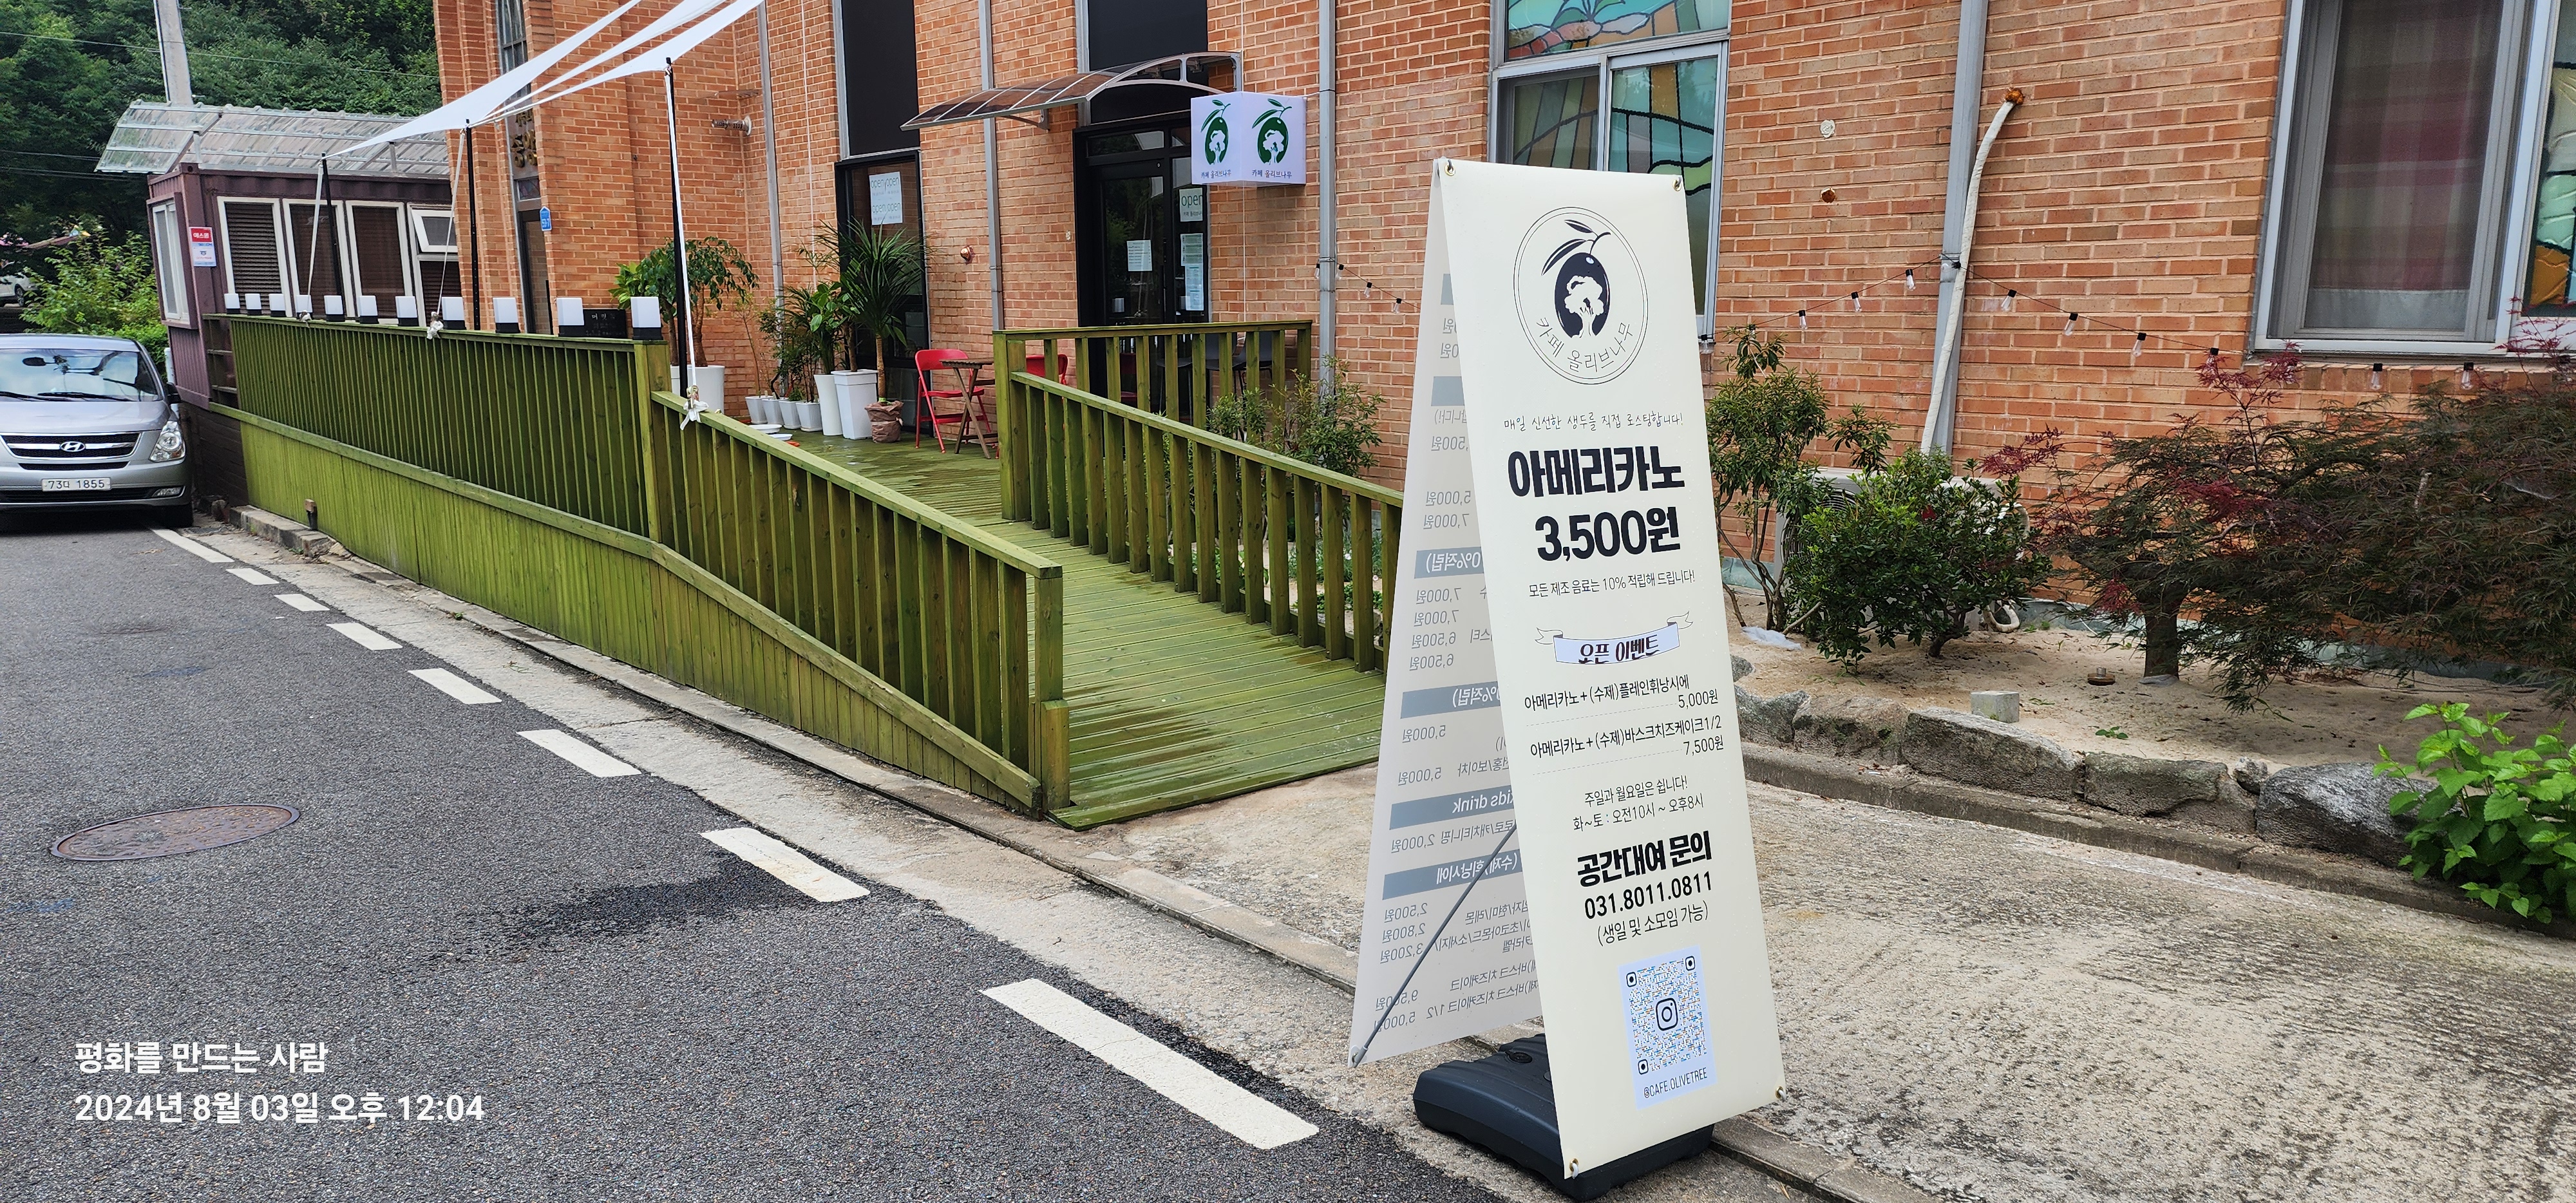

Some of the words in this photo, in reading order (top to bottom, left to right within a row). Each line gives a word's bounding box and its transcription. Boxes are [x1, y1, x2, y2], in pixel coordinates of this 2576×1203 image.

[1265, 169, 1292, 178] 올리브나무
[1537, 317, 1564, 357] 카페
[1567, 322, 1633, 372] 올리브나무
[1504, 415, 1526, 431] 매일
[1531, 413, 1561, 430] 신선한
[1567, 412, 1596, 431] 생두를
[1602, 413, 1620, 429] 직접
[1626, 411, 1683, 428] 로스팅합니다!
[77, 479, 104, 488] 1855
[1508, 446, 1685, 497] 아메리카노
[1535, 507, 1681, 562] 3,500원
[1529, 584, 1548, 598] 모든
[1551, 582, 1569, 595] 제조
[1571, 580, 1600, 594] 음료는
[1603, 577, 1626, 591] 10%
[1627, 573, 1655, 591] 적립해
[1657, 569, 1695, 585] 드립니다!
[1578, 643, 1610, 664] 오픈
[1615, 634, 1660, 662] 이벤트
[1678, 688, 1718, 709] 5,000원
[1683, 735, 1724, 757] 7,500원
[1584, 789, 1614, 808] 주일과
[1616, 781, 1654, 800] 월요일은
[1656, 775, 1688, 794] 쉽니다!
[1613, 802, 1655, 823] 오전10시
[1669, 793, 1703, 812] 오후8시
[1577, 840, 1666, 887] 공간대여
[1669, 830, 1712, 868] 문의
[1584, 871, 1712, 919] 031.8011.0811
[1598, 921, 1626, 947] (생일
[1629, 917, 1642, 938] 및
[1644, 908, 1678, 933] 소모임
[1681, 900, 1709, 923] 가능)
[1643, 1067, 1707, 1099] @CAFE.OLIVETREE
